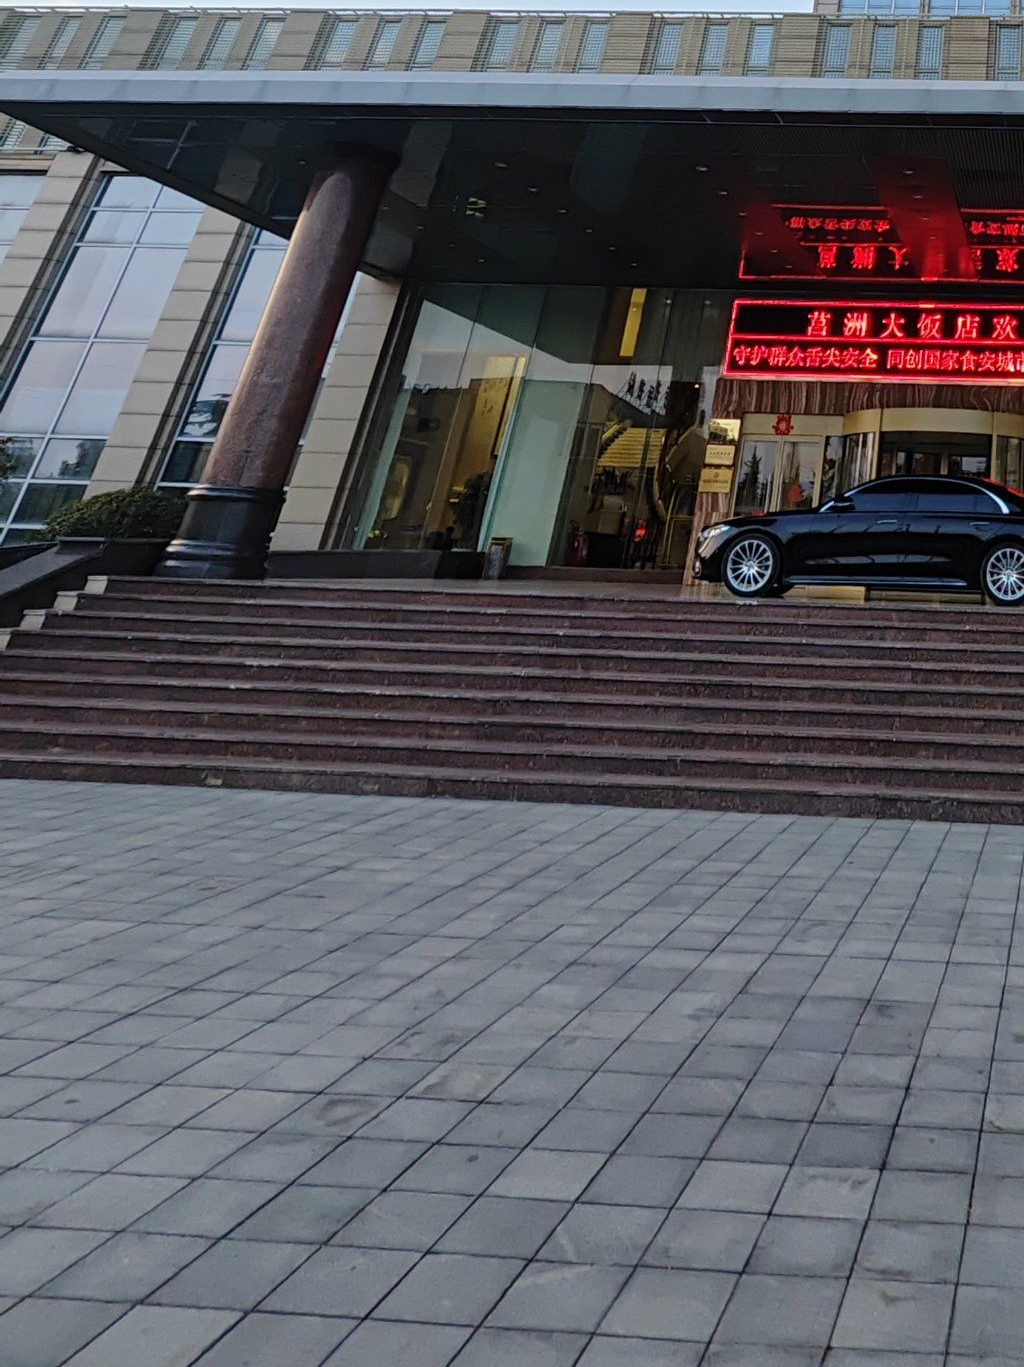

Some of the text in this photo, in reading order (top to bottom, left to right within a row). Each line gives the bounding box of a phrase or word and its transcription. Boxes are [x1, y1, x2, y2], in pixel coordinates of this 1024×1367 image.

[733, 344, 878, 369] 守护群众舌尖安全
